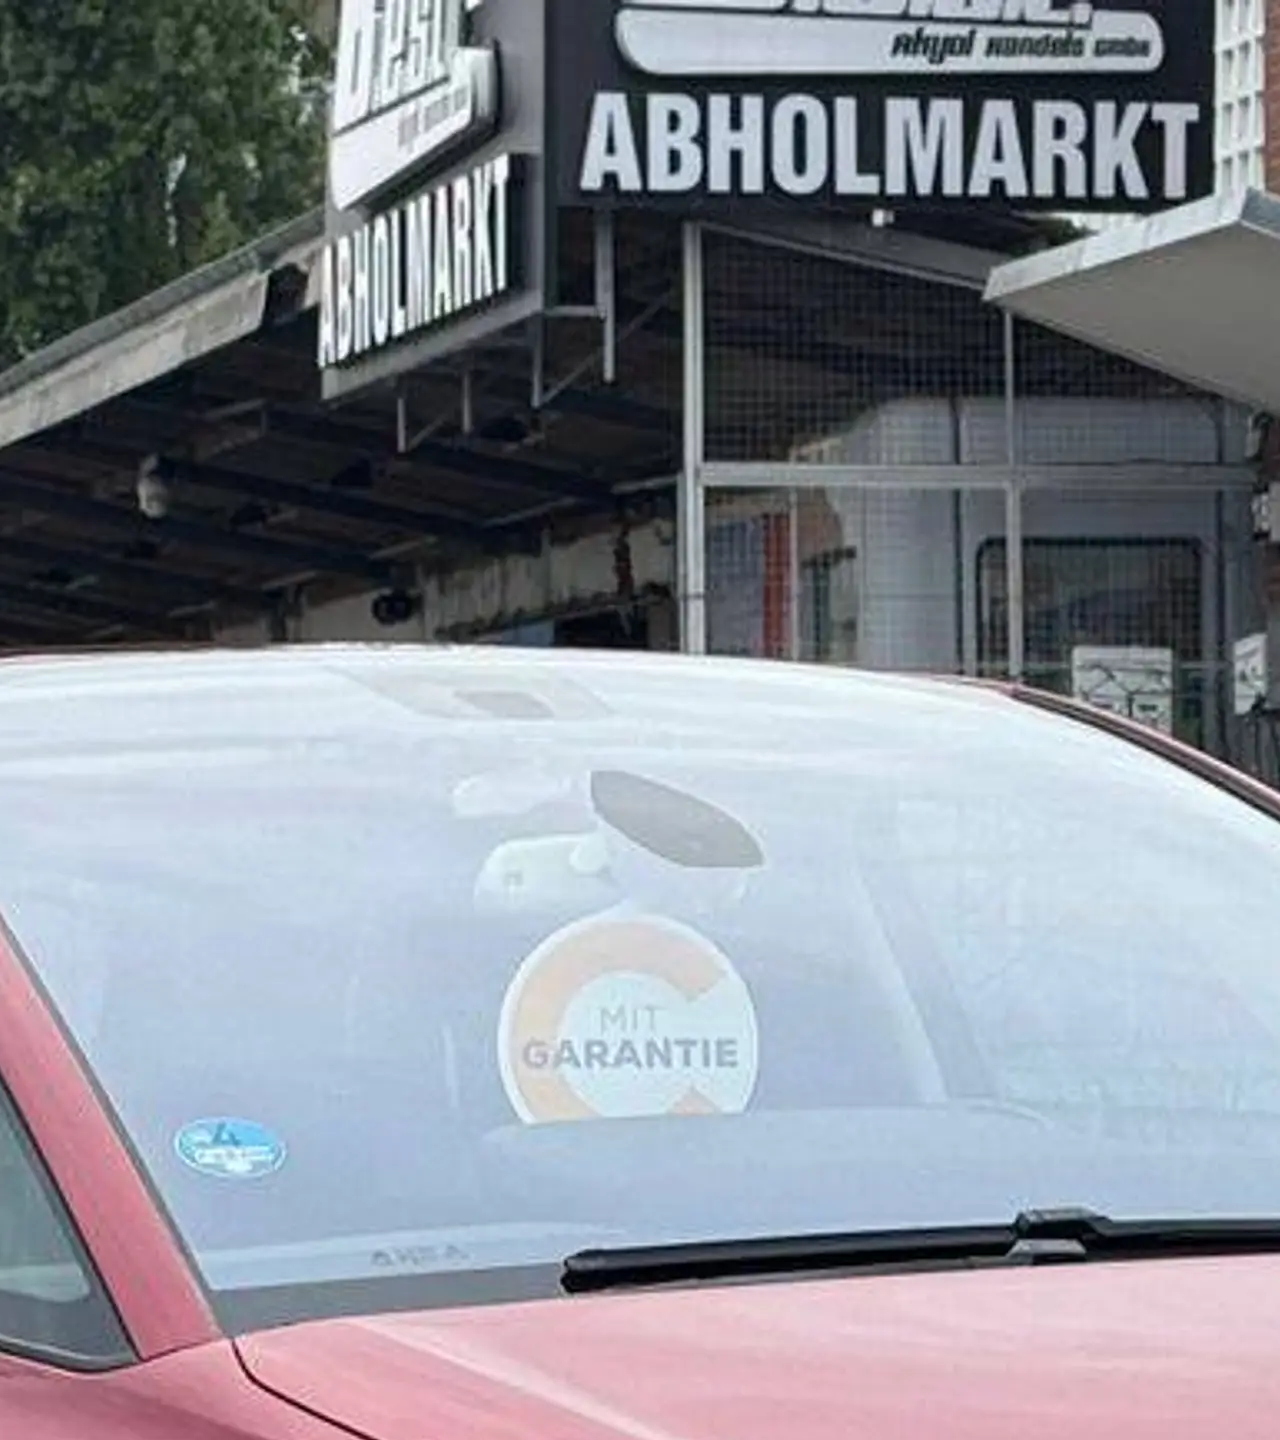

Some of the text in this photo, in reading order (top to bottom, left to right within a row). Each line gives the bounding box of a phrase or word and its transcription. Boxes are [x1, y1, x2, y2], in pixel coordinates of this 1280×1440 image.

[580, 91, 1200, 201] ABHOLMARKT
[316, 152, 510, 370] ABHOLMARKT
[522, 1038, 739, 1070] GARANTIE
[599, 1005, 668, 1034] MIT
